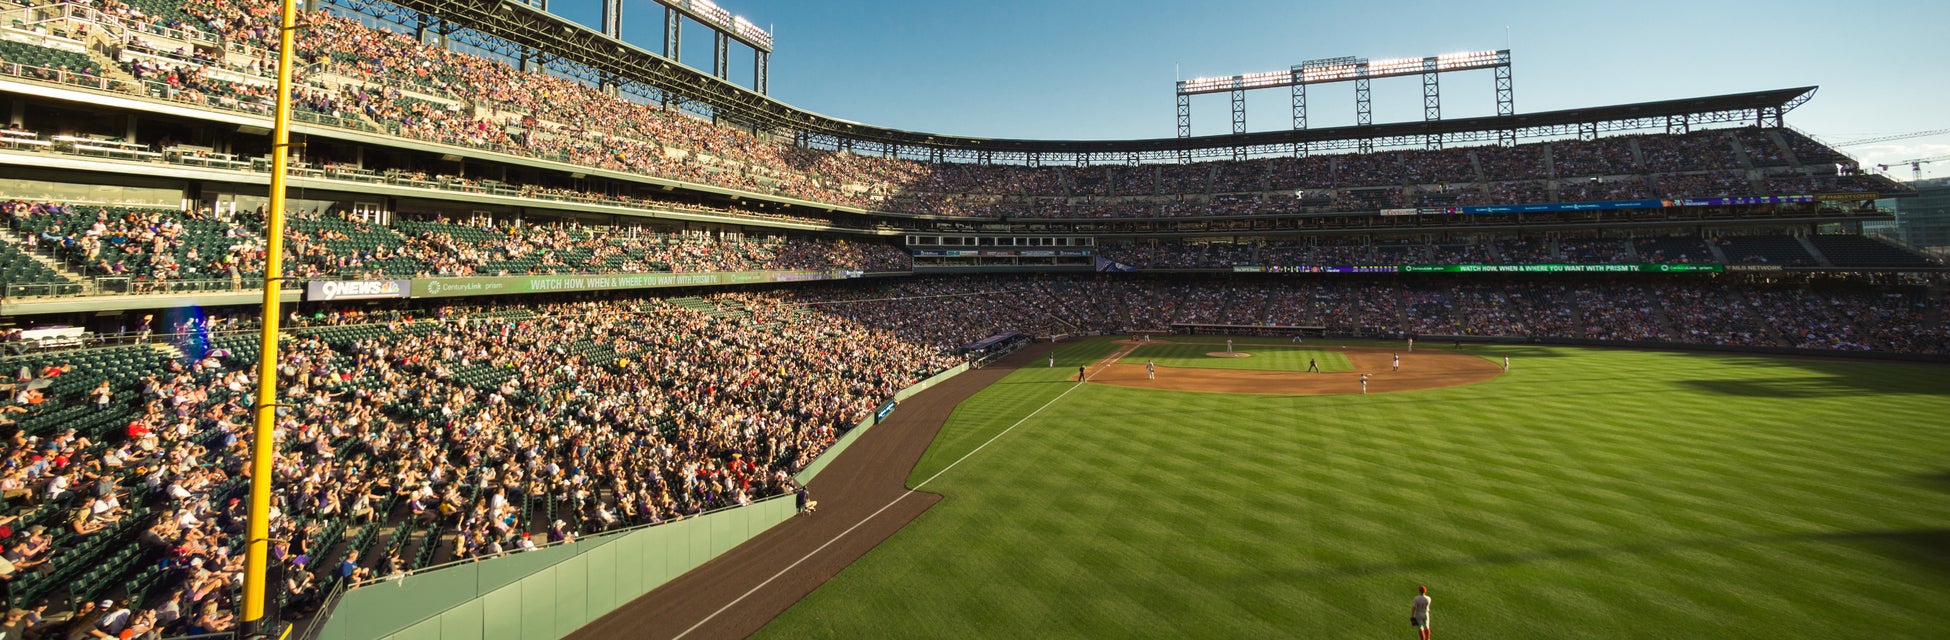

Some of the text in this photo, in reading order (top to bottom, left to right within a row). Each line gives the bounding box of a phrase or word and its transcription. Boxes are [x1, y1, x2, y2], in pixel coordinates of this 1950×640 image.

[443, 282, 503, 291] CenturyLink prism
[531, 279, 562, 290] WATCH
[564, 279, 585, 290] HOW,
[587, 278, 610, 288] WHEN
[611, 278, 617, 287] &
[619, 277, 642, 287] WHERE
[644, 277, 657, 285] YOU
[658, 276, 676, 285] WANT
[677, 275, 692, 284] WITH
[693, 275, 710, 284] PRISM
[322, 281, 382, 300] 9NEWS
